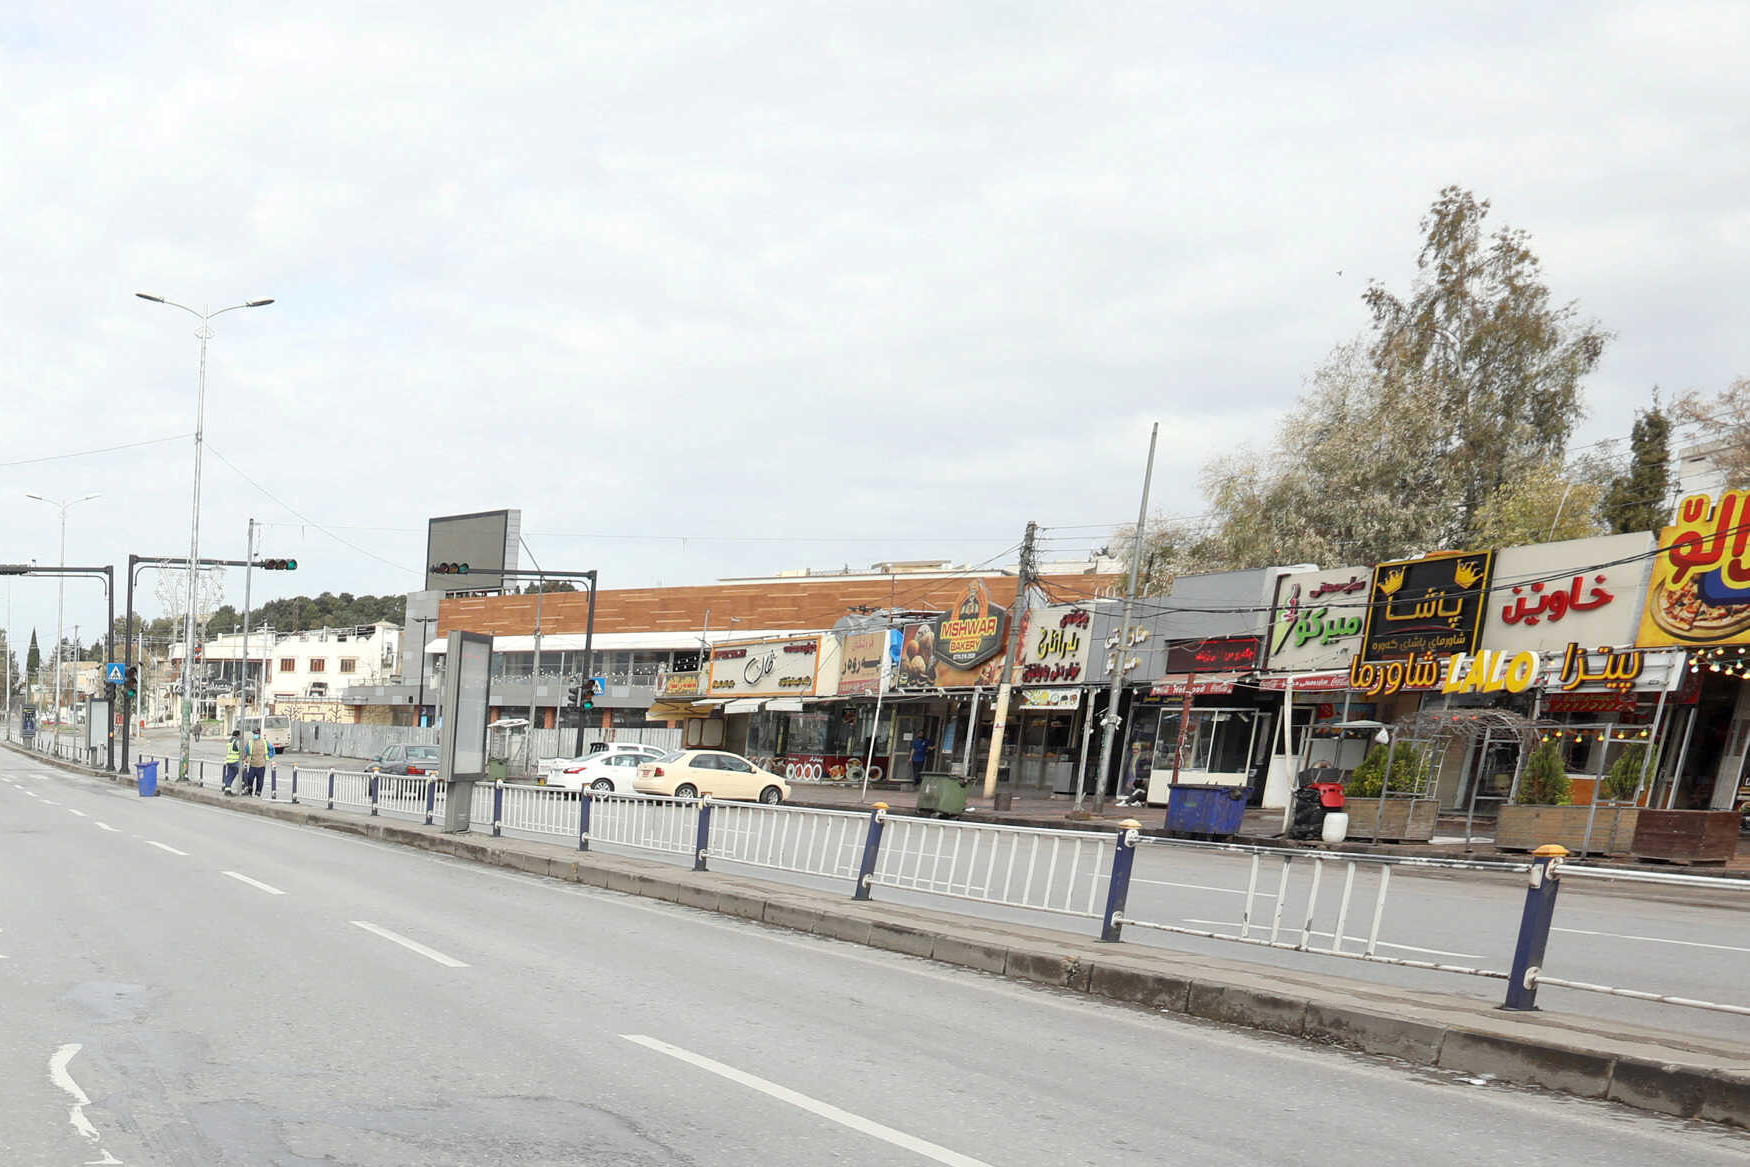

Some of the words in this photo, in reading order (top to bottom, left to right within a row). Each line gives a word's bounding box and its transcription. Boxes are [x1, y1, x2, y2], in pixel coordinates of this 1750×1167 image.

[940, 617, 998, 640] MSHWAR
[1386, 587, 1464, 629] پاشا
[949, 638, 982, 653] BAKERY
[1560, 642, 1644, 692] پیتزا
[1350, 651, 1440, 697] شاورما
[1442, 649, 1540, 694] LALO
